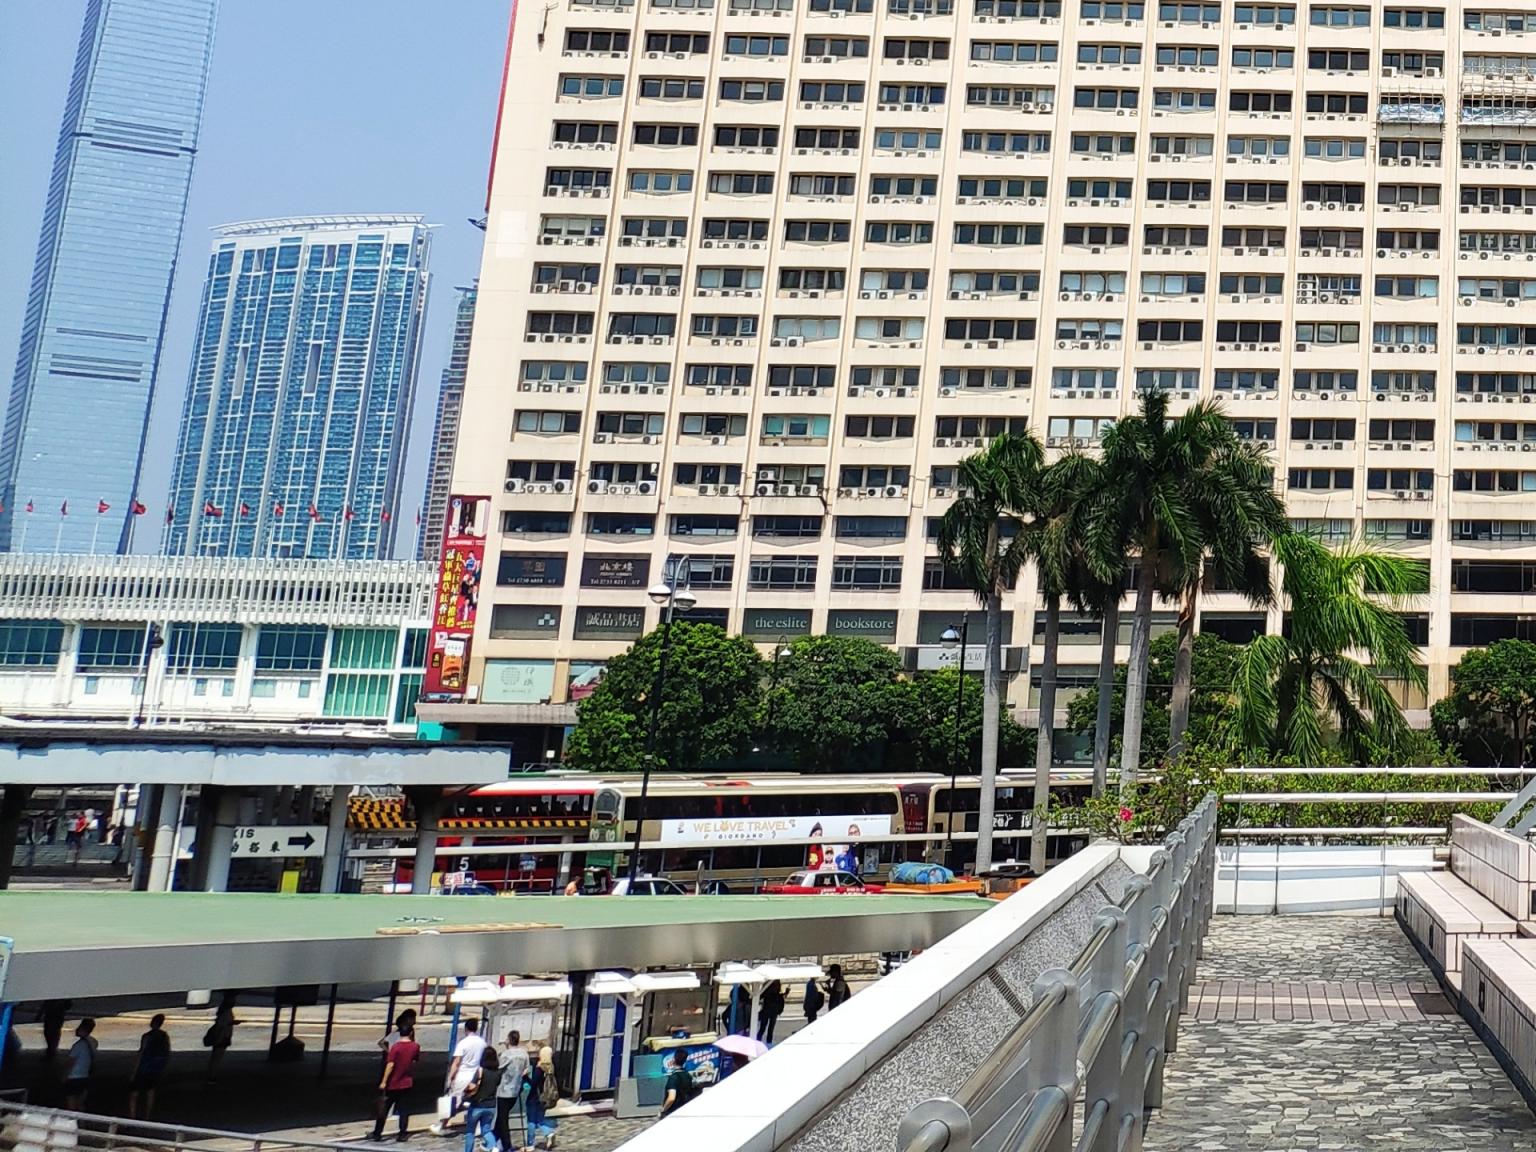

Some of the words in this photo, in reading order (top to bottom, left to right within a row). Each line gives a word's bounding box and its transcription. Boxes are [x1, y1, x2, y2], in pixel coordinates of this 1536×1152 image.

[755, 616, 774, 628] the
[775, 616, 808, 629] eslite
[835, 617, 894, 630] bookstore
[693, 822, 713, 833] WE
[748, 821, 789, 833] TRAVEL
[458, 856, 470, 871] 5
